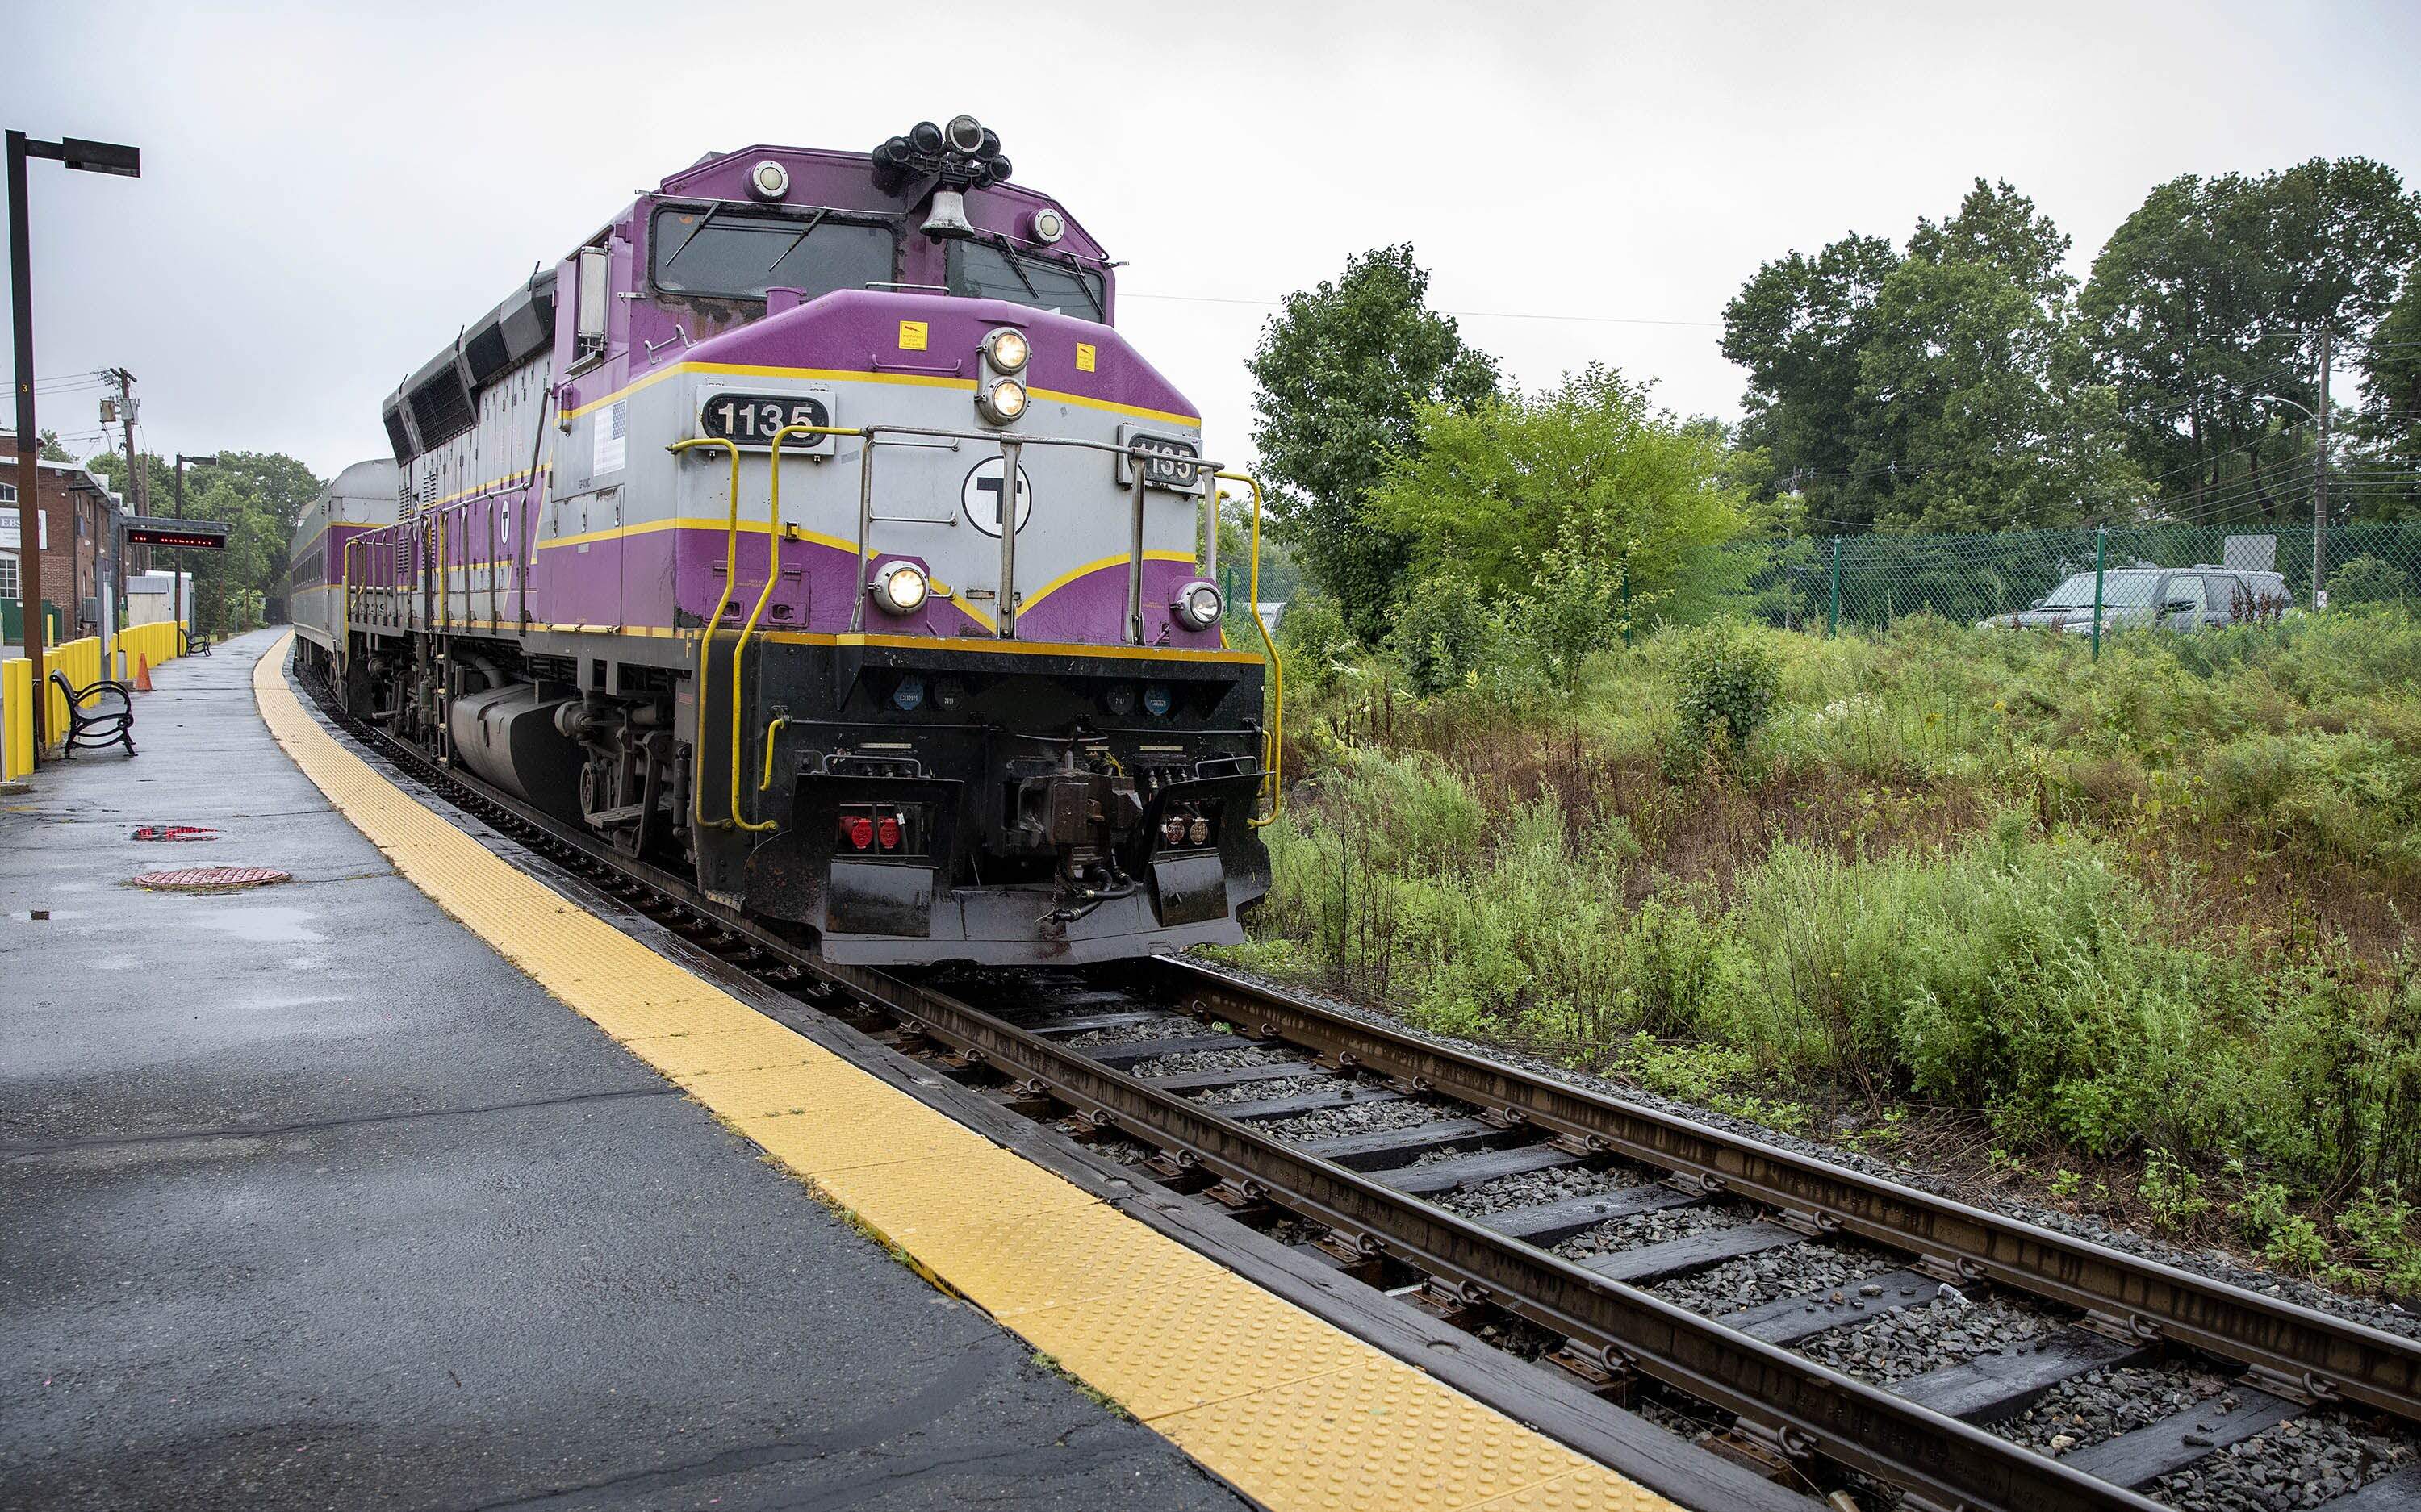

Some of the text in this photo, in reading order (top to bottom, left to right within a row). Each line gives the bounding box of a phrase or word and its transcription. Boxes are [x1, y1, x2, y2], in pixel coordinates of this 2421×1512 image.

[22, 384, 27, 392] 3
[718, 403, 813, 439] 1135
[977, 477, 1022, 524] T
[686, 632, 692, 658] F
